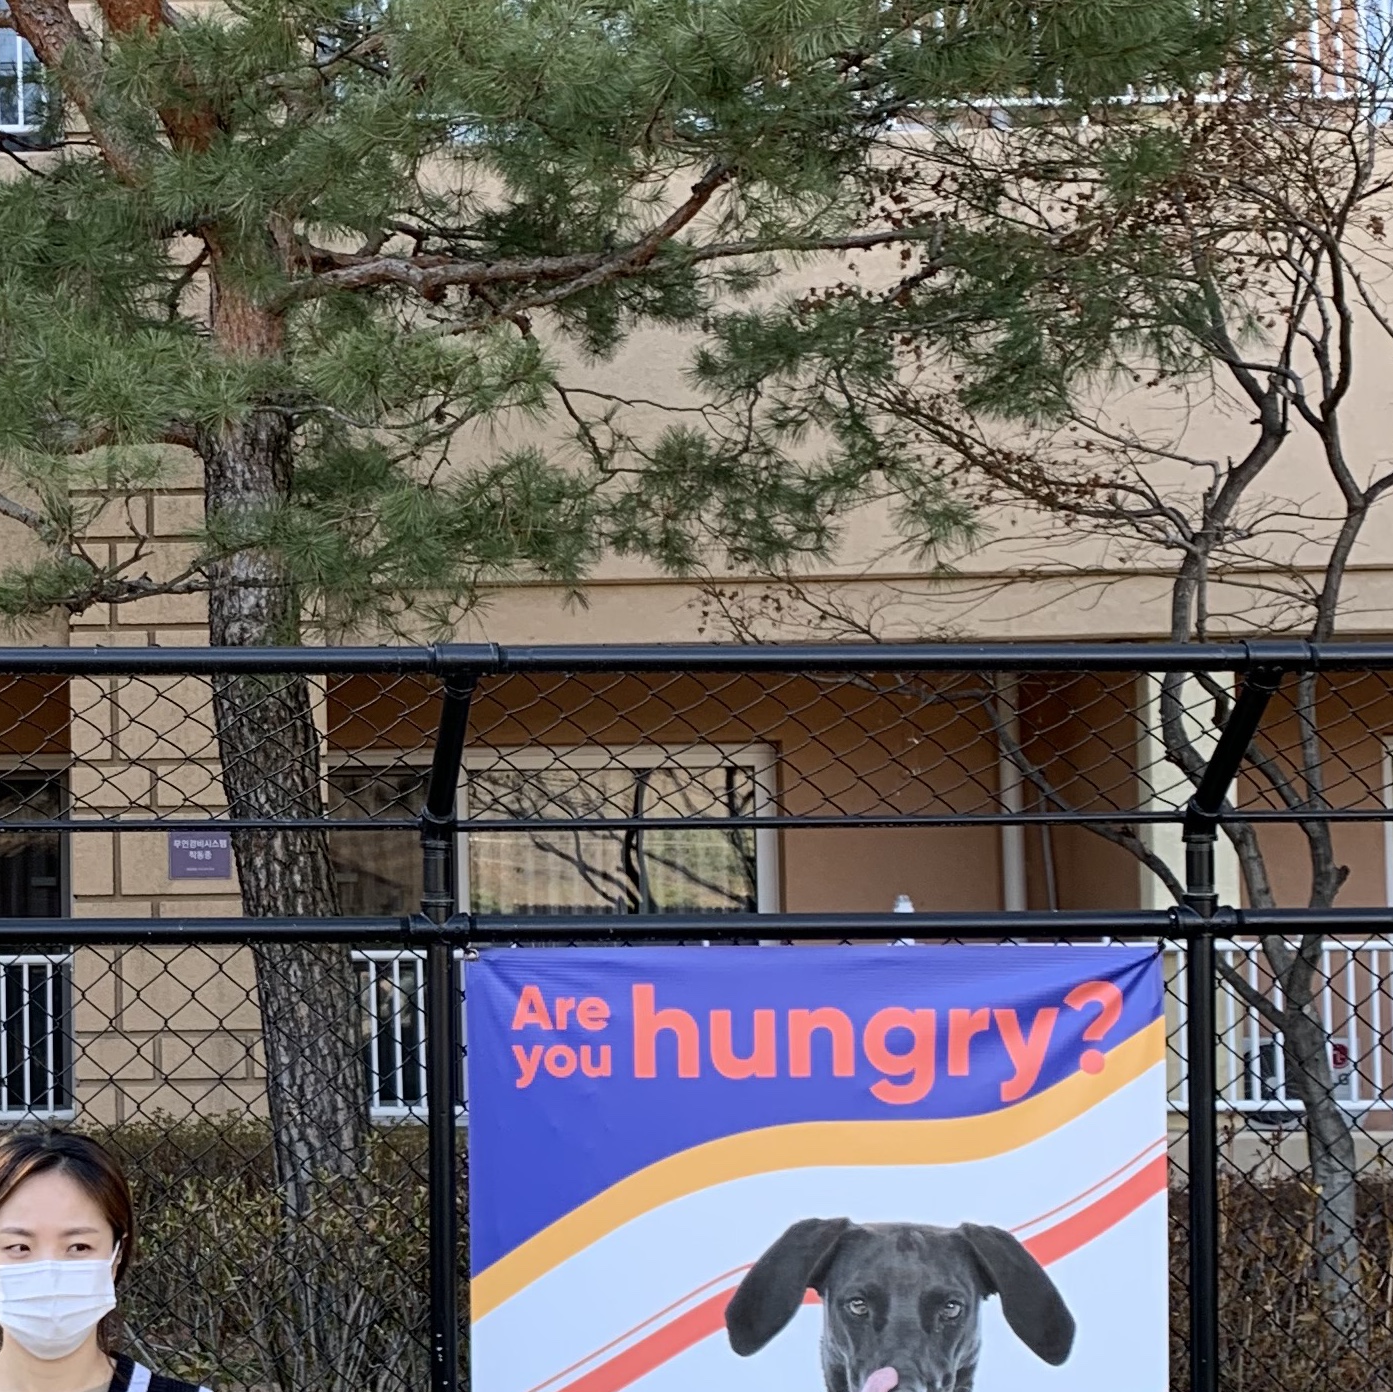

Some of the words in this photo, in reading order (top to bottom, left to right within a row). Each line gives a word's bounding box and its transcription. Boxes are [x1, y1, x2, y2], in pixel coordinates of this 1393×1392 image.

[511, 985, 609, 1031] Are
[512, 1043, 611, 1089] you
[632, 980, 1124, 1105] hungry?
